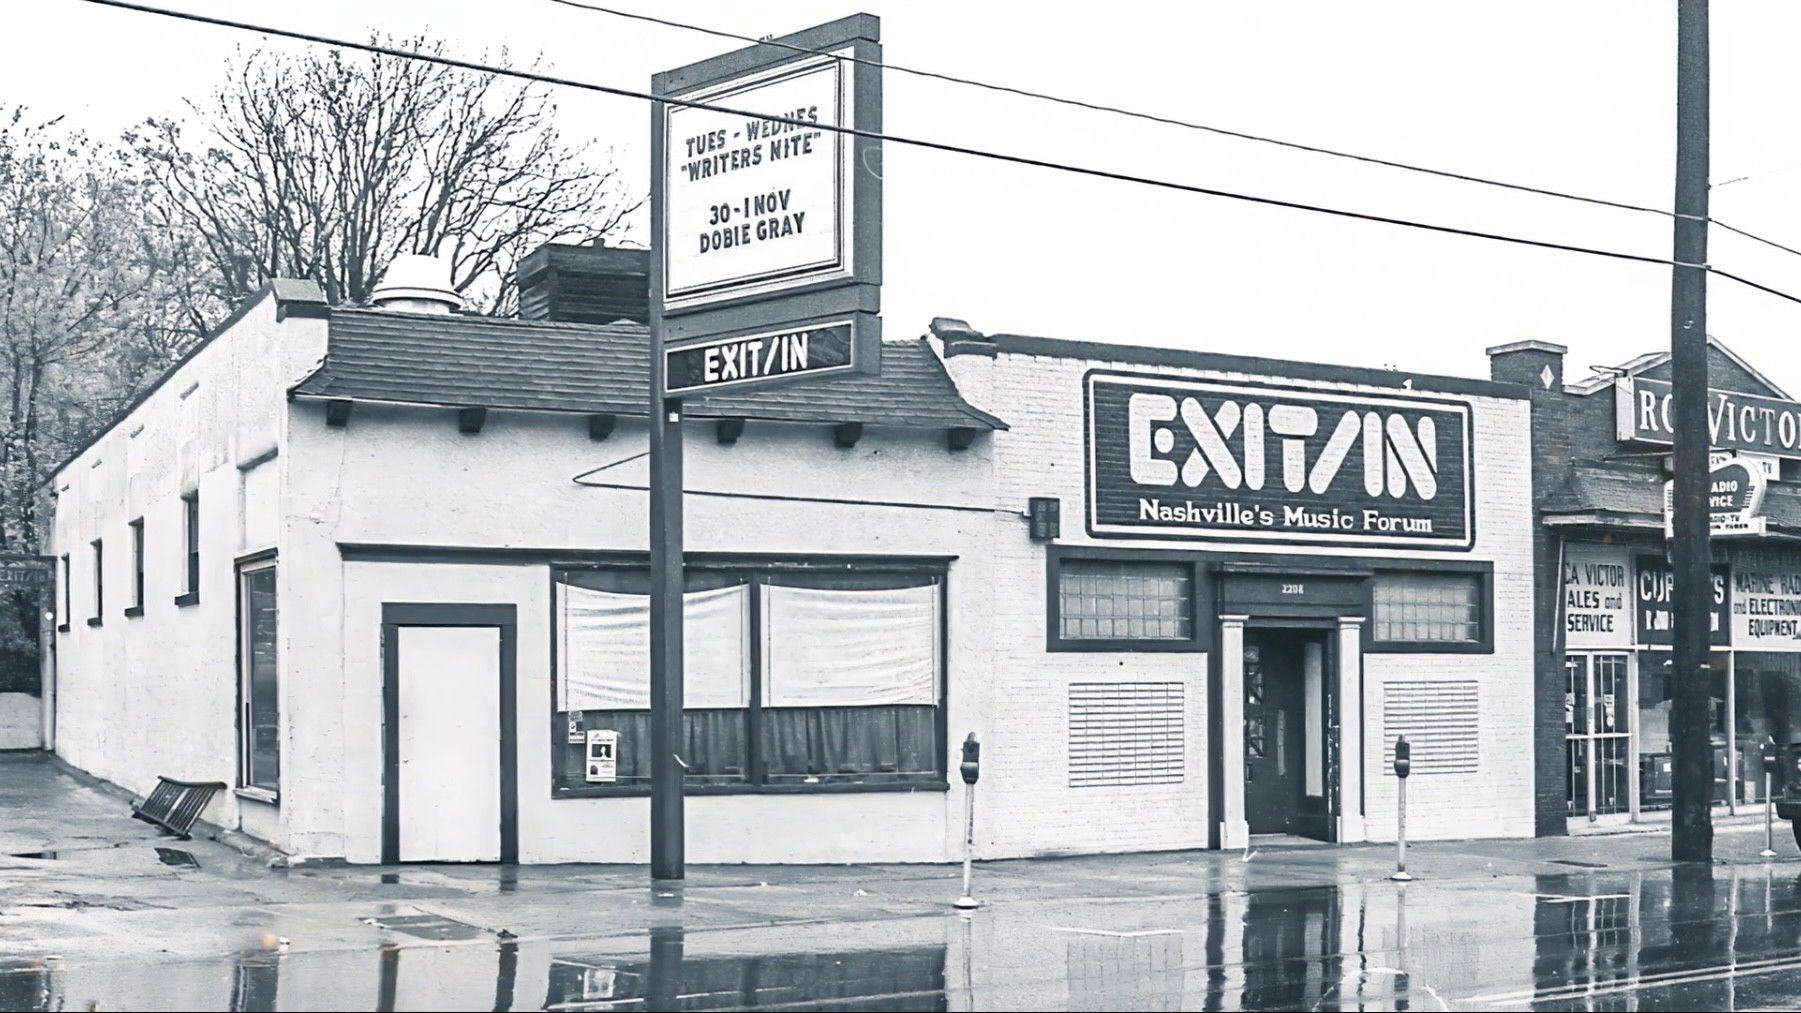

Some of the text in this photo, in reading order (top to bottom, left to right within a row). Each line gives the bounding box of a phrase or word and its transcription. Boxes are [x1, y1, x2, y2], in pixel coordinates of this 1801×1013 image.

[685, 129, 727, 158] TUES
[746, 105, 818, 141] WEDNES
[681, 131, 821, 182] "WRITERS NITE"
[754, 188, 792, 216] NOV
[700, 211, 806, 254] DOBIE GRAY
[704, 332, 809, 383] EXIT/IN
[1128, 392, 1438, 501] EXIT/IN
[1710, 480, 1738, 493] ADIO
[1139, 498, 1433, 533] Nashville's Music Forum
[1585, 563, 1625, 588] VICTOR
[1567, 590, 1600, 609] ALES
[1567, 613, 1614, 633] SERVICE
[1748, 618, 1798, 639] EQUIPMENT
